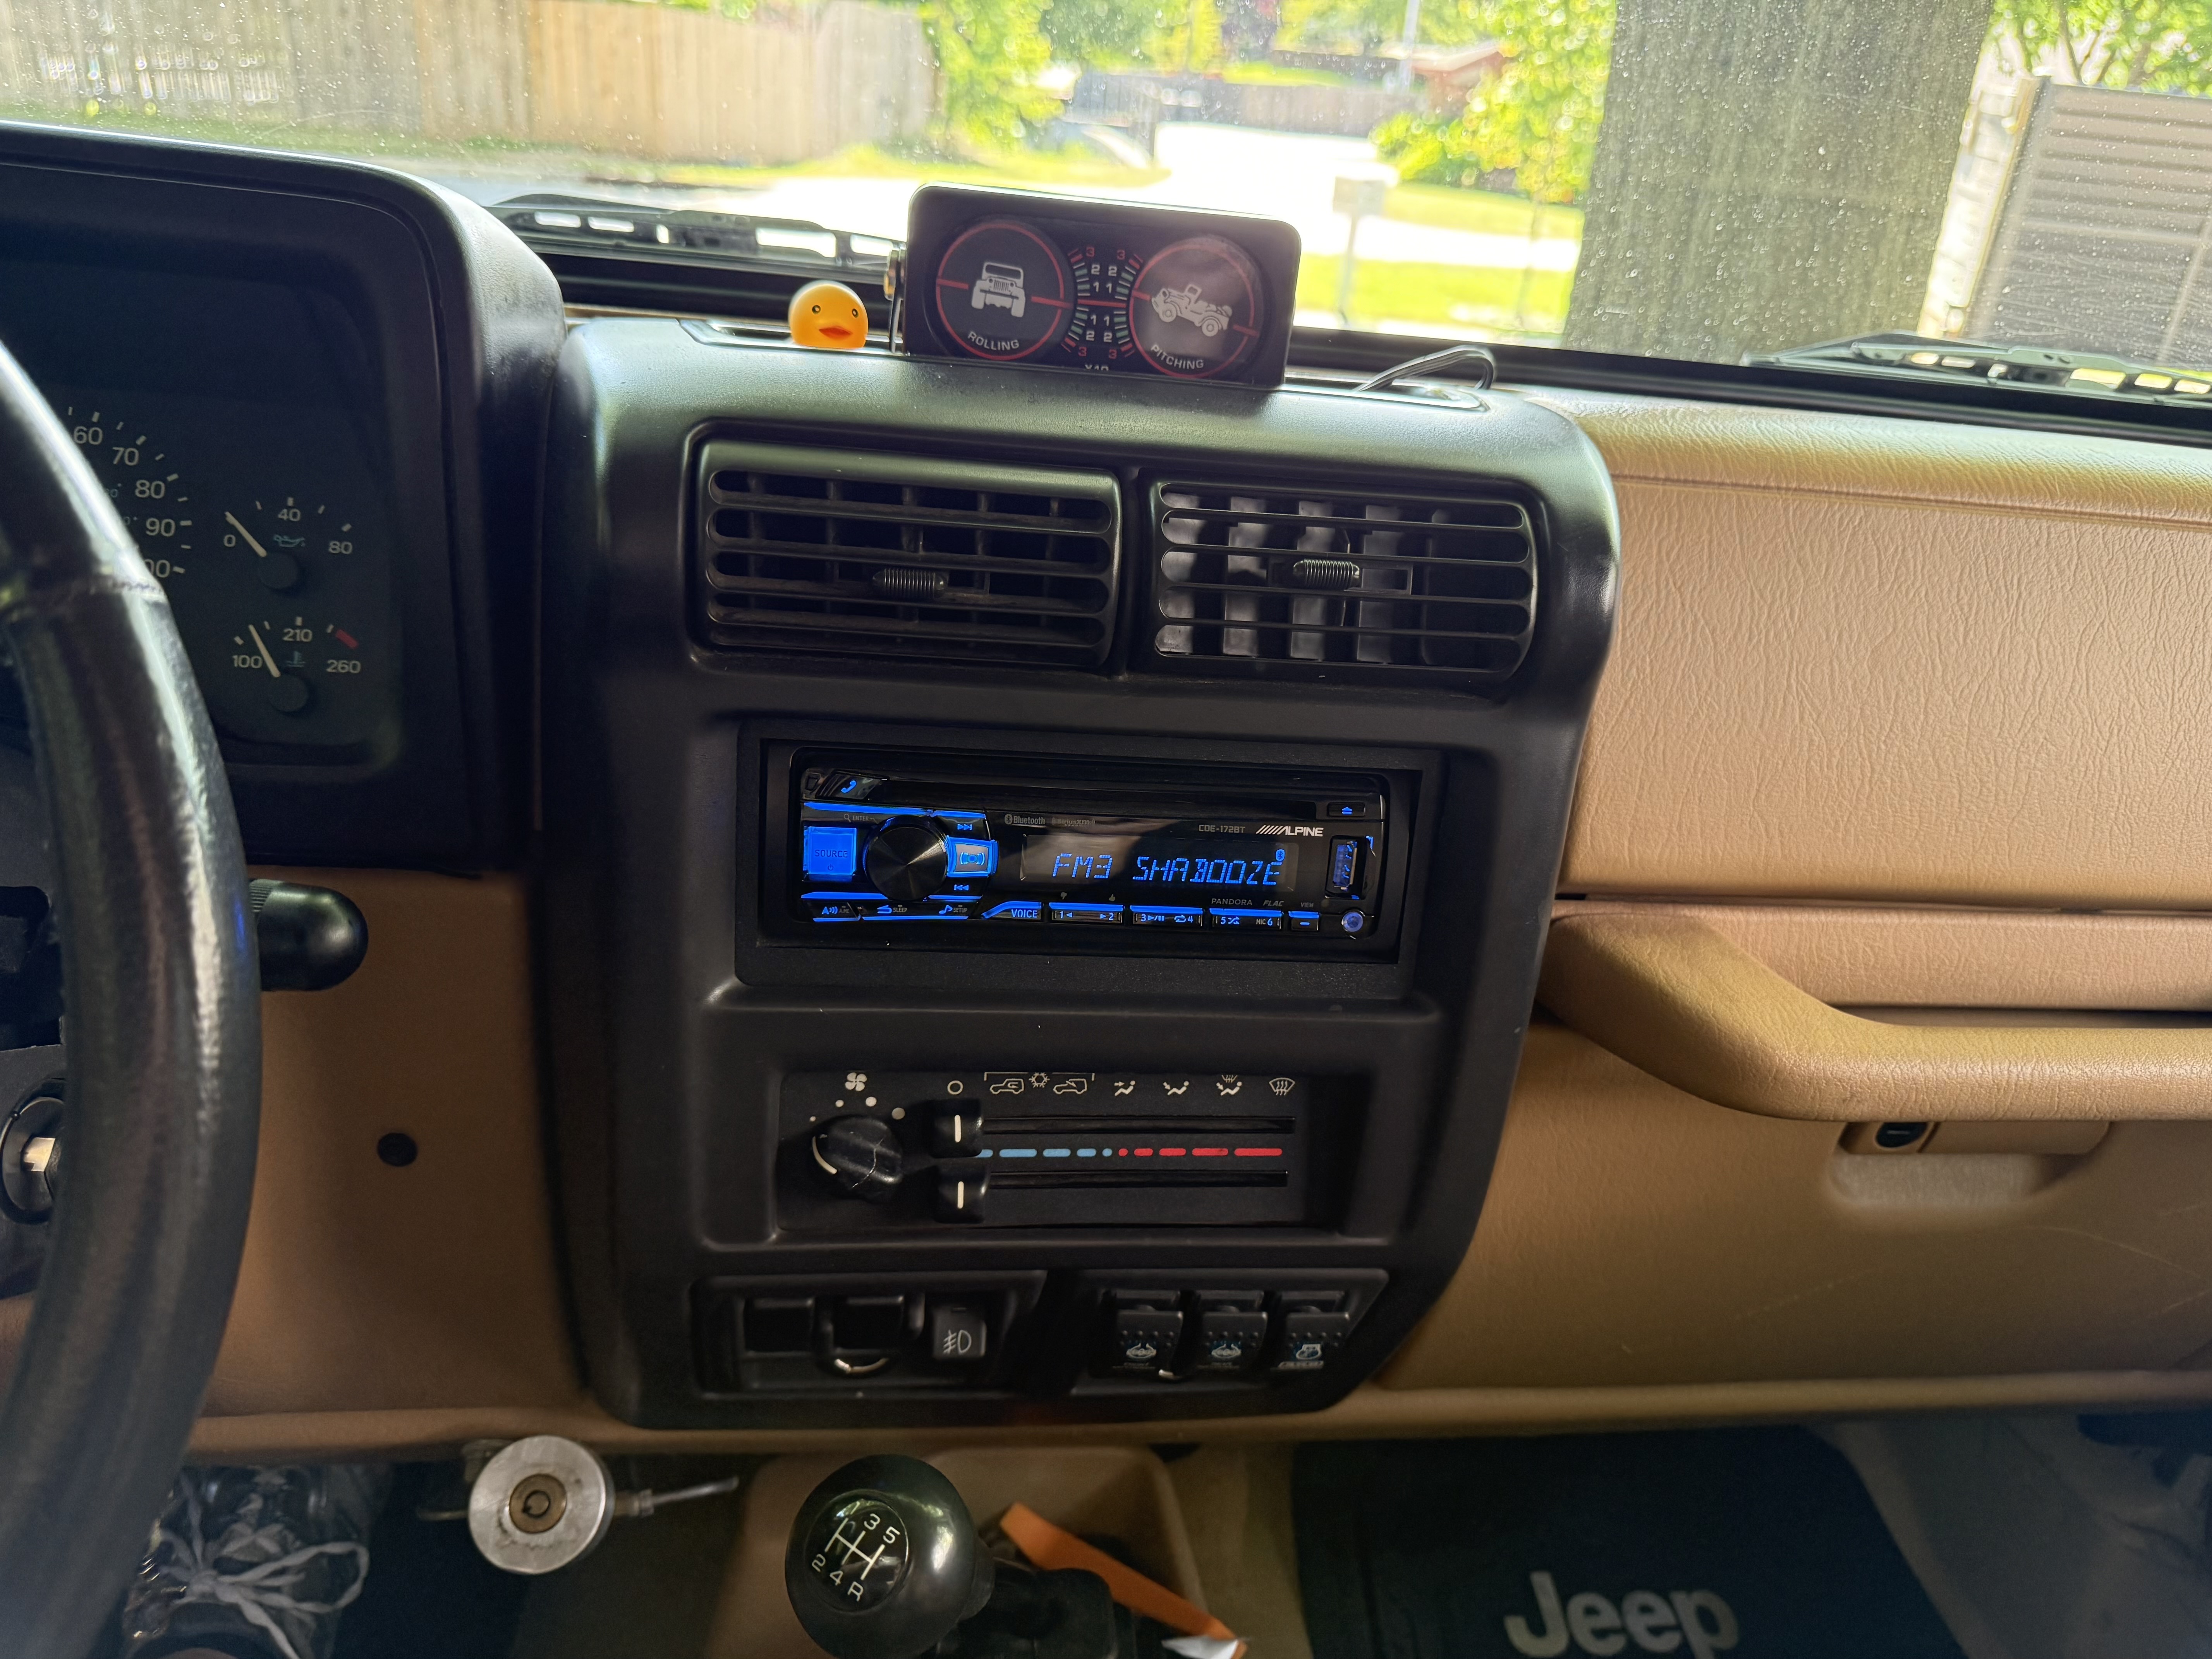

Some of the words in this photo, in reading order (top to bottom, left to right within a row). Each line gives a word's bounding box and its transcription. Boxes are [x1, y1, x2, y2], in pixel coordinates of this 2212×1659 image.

[1086, 247, 1094, 258] 3
[1117, 249, 1125, 260] 3
[1091, 264, 1100, 275] 2
[1108, 265, 1117, 276] 2
[1094, 282, 1099, 292] 1
[1106, 283, 1112, 293] 1
[1091, 315, 1096, 325] 1
[1104, 316, 1109, 326] 1
[967, 331, 1020, 350] ROLLING
[1086, 330, 1094, 342] 2
[1104, 331, 1112, 343] 2
[1078, 345, 1087, 356] 3
[1109, 349, 1117, 359] 3
[1150, 344, 1204, 370] PITCHING
[74, 426, 103, 445] 60
[112, 447, 139, 466] 70
[135, 480, 165, 499] 80
[278, 508, 301, 521] 40
[145, 519, 175, 537] 90
[223, 534, 236, 547] 0
[328, 541, 352, 555] 80
[283, 629, 313, 642] 210
[232, 655, 263, 669] 100
[326, 659, 361, 673] 260
[1013, 816, 1045, 825] Bluetooth
[1199, 824, 1245, 834] CDE-172BT
[1278, 826, 1324, 836] ALPINE
[815, 849, 848, 858] SOURCE
[1052, 853, 1113, 879] FM3
[1132, 856, 1283, 886] SHABOOZE
[1211, 898, 1252, 907] PANDORA
[1011, 909, 1037, 919] VOICE
[864, 1513, 881, 1530] 3
[883, 1526, 900, 1544] 5
[812, 1553, 826, 1572] 2
[829, 1570, 843, 1586] 4
[847, 1581, 864, 1602] R
[1503, 1571, 1738, 1659] Jeep
